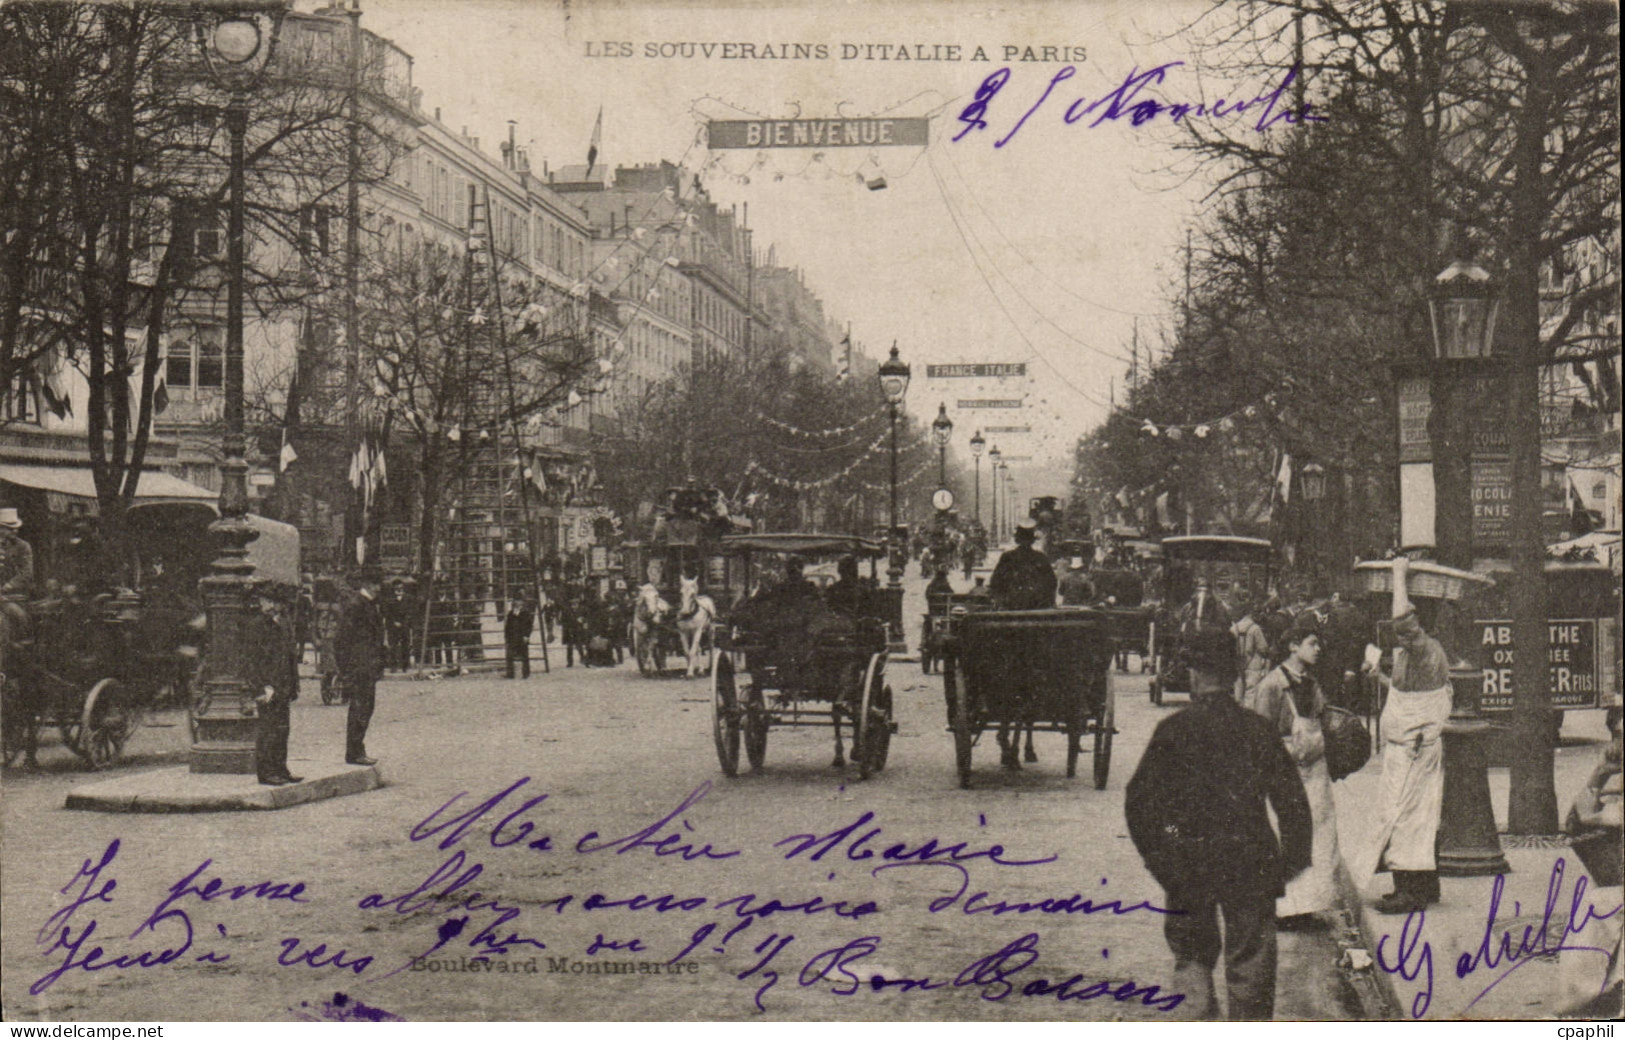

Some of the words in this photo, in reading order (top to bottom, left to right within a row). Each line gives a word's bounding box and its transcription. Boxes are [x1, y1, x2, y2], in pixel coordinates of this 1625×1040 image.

[746, 119, 895, 147] BIENVENUE
[934, 366, 976, 377] FRANCE
[985, 364, 1020, 376] ITALIE
[773, 810, 1059, 867] Marie
[36, 838, 121, 945] Je
